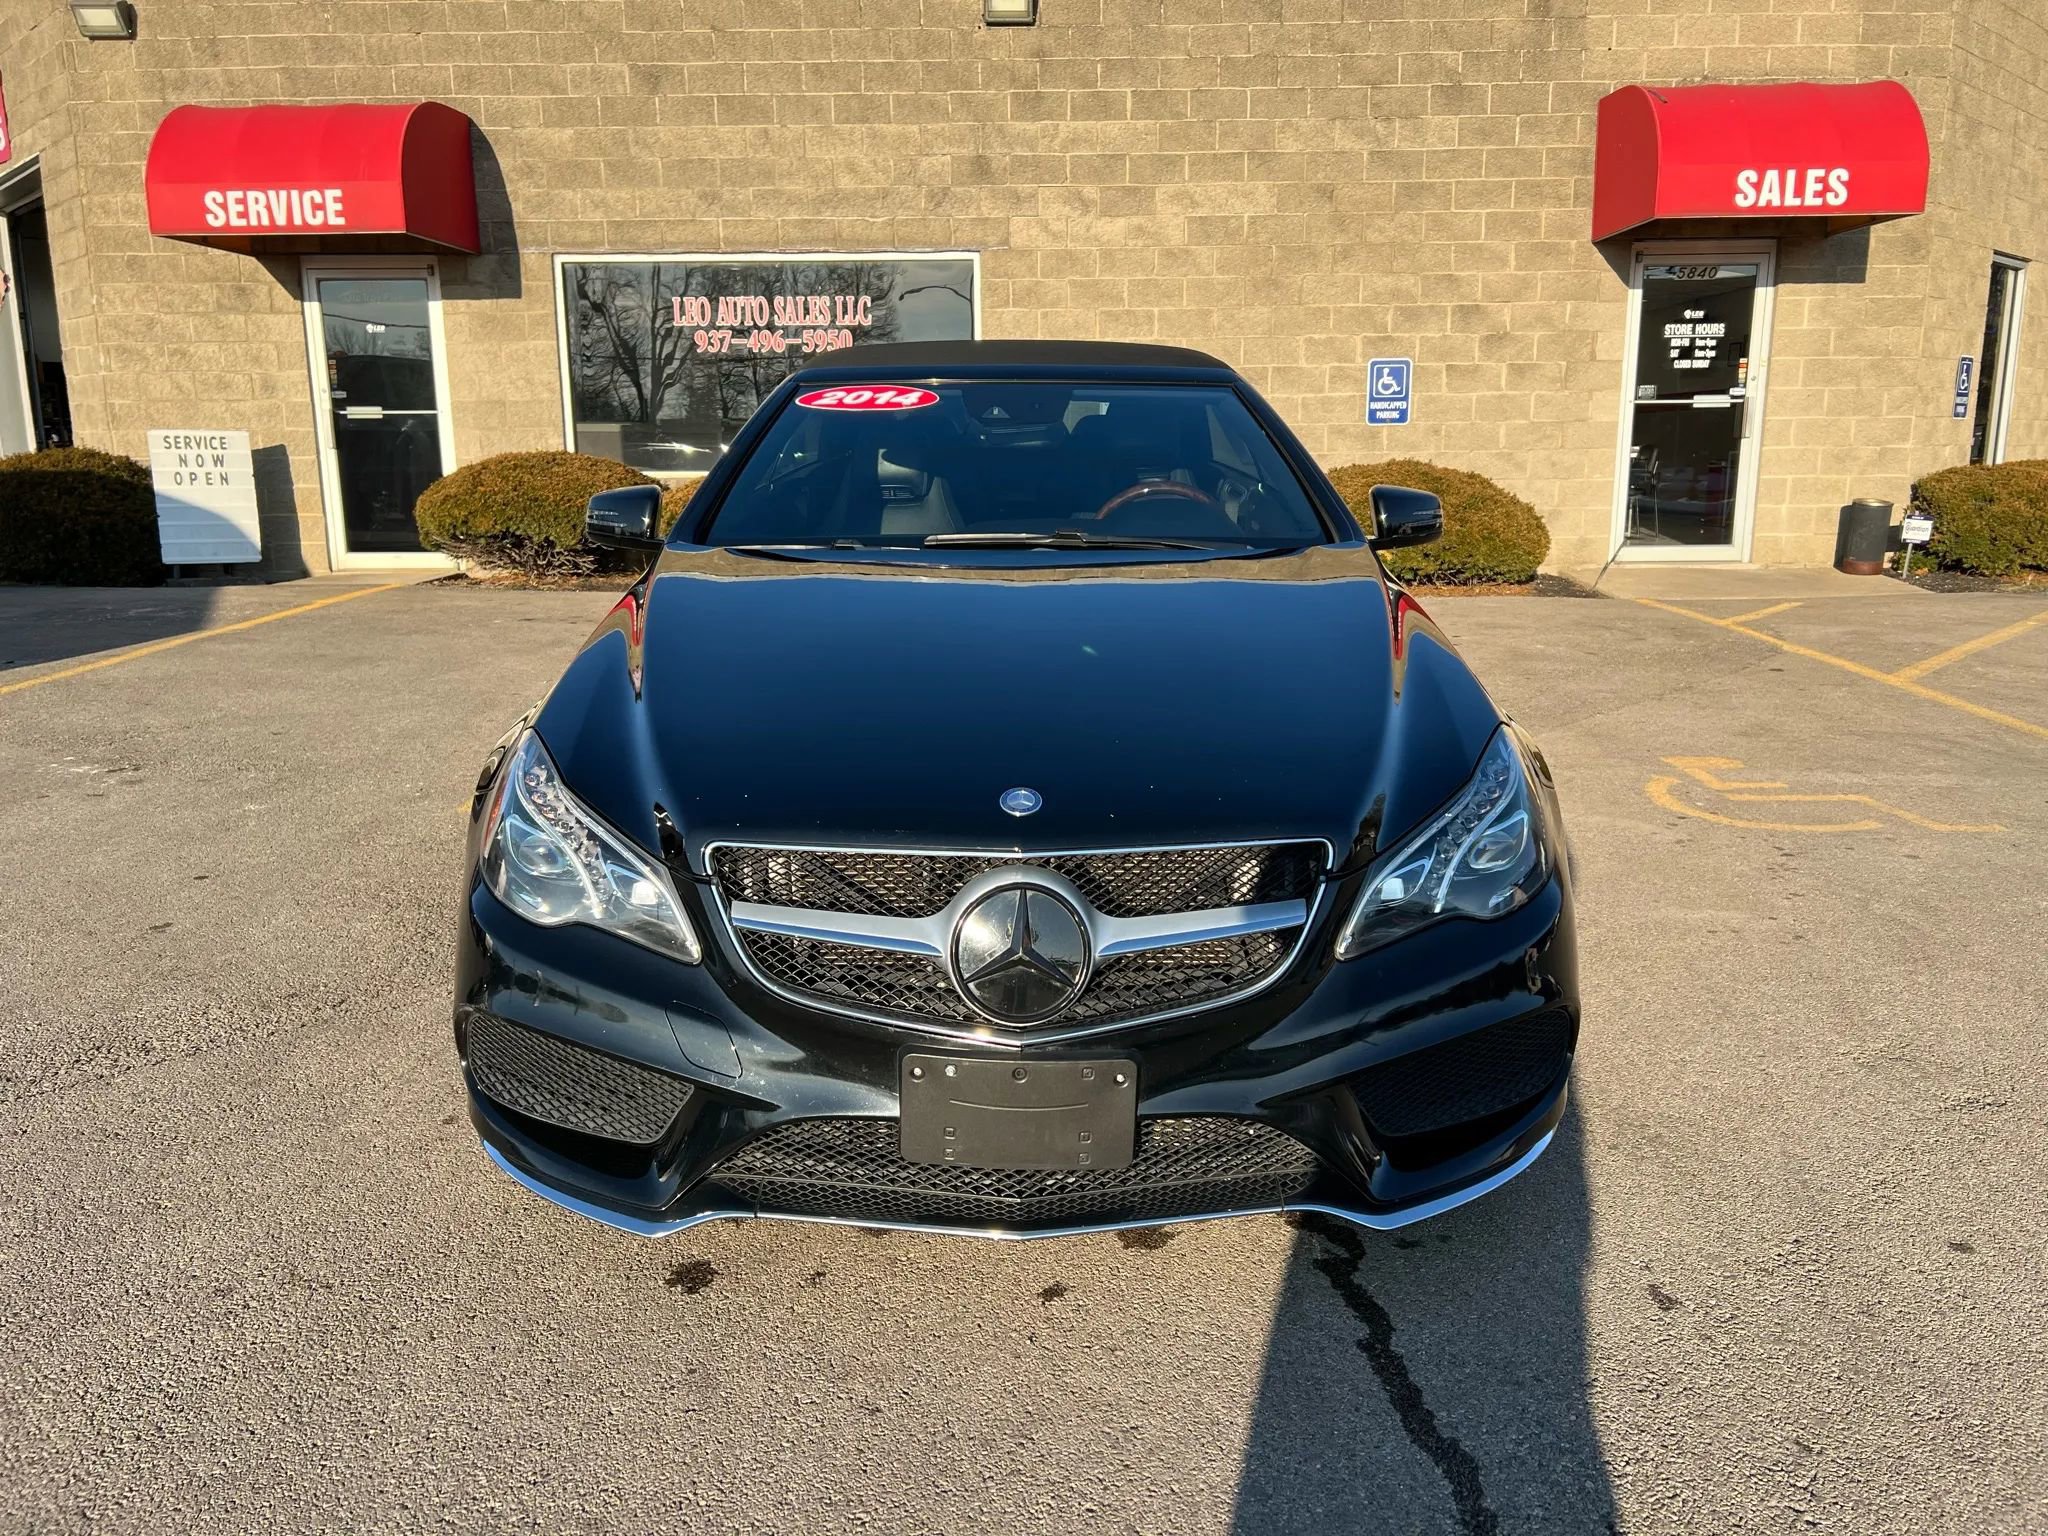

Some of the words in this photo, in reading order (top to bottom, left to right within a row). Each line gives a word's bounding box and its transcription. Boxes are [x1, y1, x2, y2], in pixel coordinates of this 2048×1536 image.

[1735, 167, 1850, 209] SALES
[204, 188, 347, 228] SERVICE
[1677, 266, 1719, 279] 5840
[672, 296, 711, 327] LEO
[716, 296, 768, 326] AUTO
[774, 295, 831, 326] SALES
[836, 295, 873, 326] LLC
[1664, 323, 1693, 335] STORE
[1695, 323, 1725, 335] HOURS
[694, 329, 853, 353] 937-496-5950
[812, 390, 922, 406] 2014
[1370, 401, 1407, 409] HANDICAPPED
[1376, 410, 1400, 419] PARKING
[163, 434, 229, 450] SERVICE
[178, 453, 226, 468] NOW
[174, 471, 230, 487] OPEN
